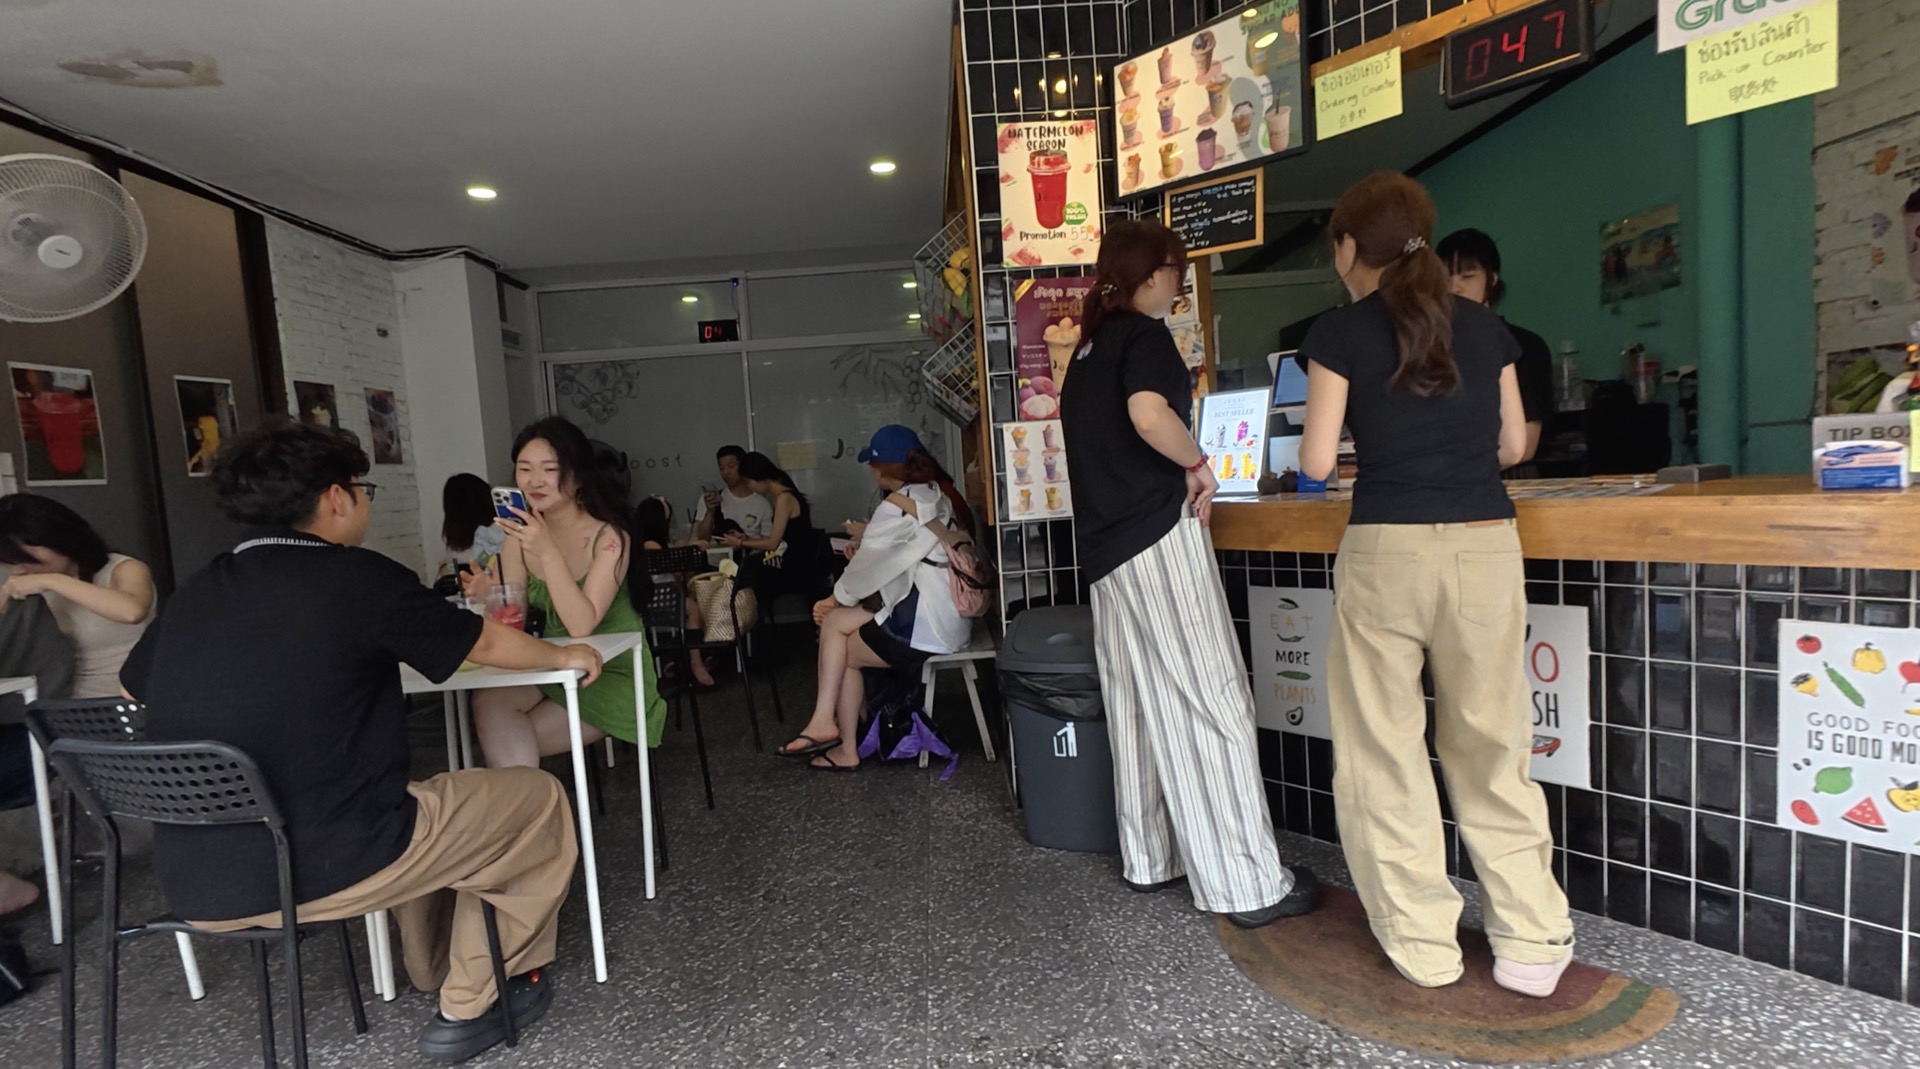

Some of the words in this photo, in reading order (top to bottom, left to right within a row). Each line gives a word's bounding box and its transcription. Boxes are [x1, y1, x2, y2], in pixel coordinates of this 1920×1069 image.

[1466, 10, 1566, 81] 047
[1762, 40, 1829, 67] Counter
[1319, 94, 1358, 112] Ordering
[1361, 79, 1397, 97] Counter
[1007, 125, 1084, 138] WATERMELON
[1026, 138, 1066, 151] SEASON
[1214, 410, 1230, 418] BEST
[1230, 408, 1255, 416] SELLER
[1828, 427, 1864, 441] TIP
[1269, 613, 1313, 630] EAT
[1275, 649, 1312, 666] MORE
[1273, 682, 1317, 705] PLANTS
[1807, 711, 1871, 733] GOOD
[1883, 720, 1920, 739] FOO
[1807, 729, 1825, 751] IS
[1832, 733, 1883, 760] GOOD
